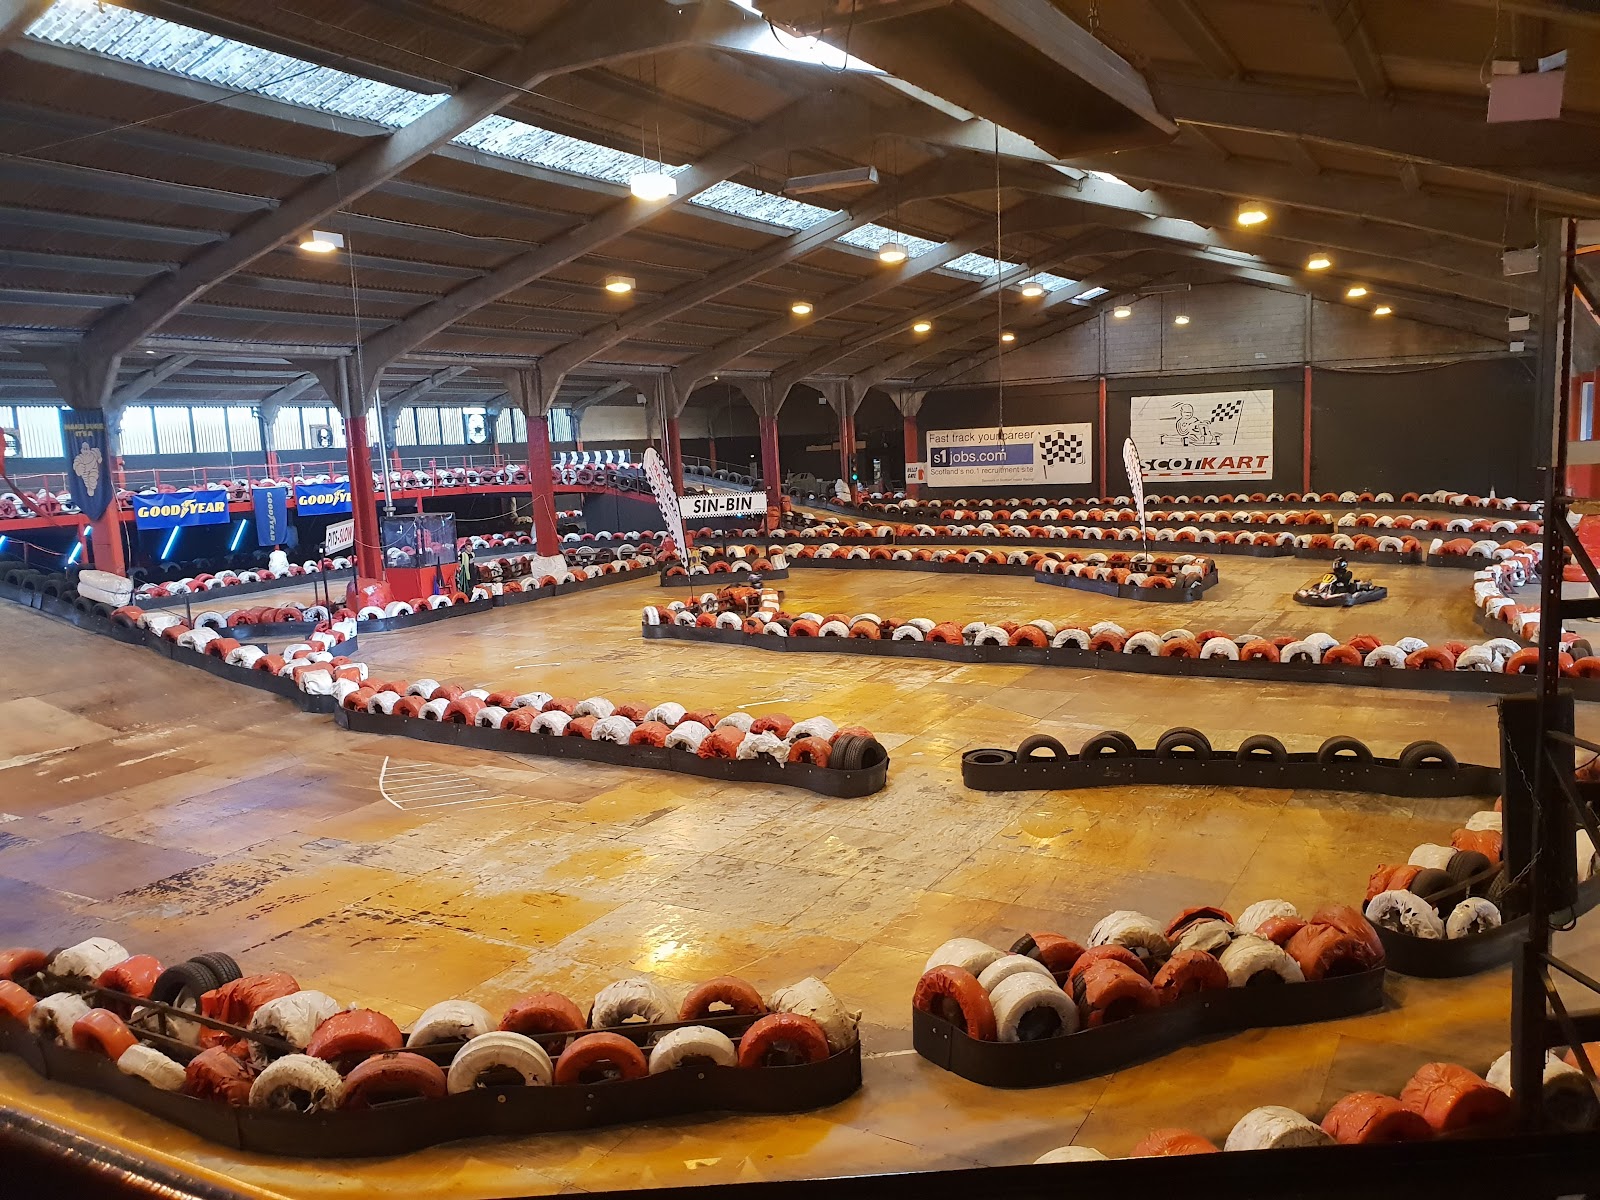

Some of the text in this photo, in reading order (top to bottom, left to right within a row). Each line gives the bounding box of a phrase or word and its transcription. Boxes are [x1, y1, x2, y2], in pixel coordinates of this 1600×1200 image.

[929, 434, 949, 443] Fast
[952, 433, 975, 442] track
[1003, 431, 1034, 440] career
[981, 466, 1020, 474] recruitment
[299, 489, 352, 506] GOODYE
[693, 496, 753, 513] SIN-BIN
[137, 499, 226, 519] GOODYEAR
[266, 491, 276, 541] GOODYEAR
